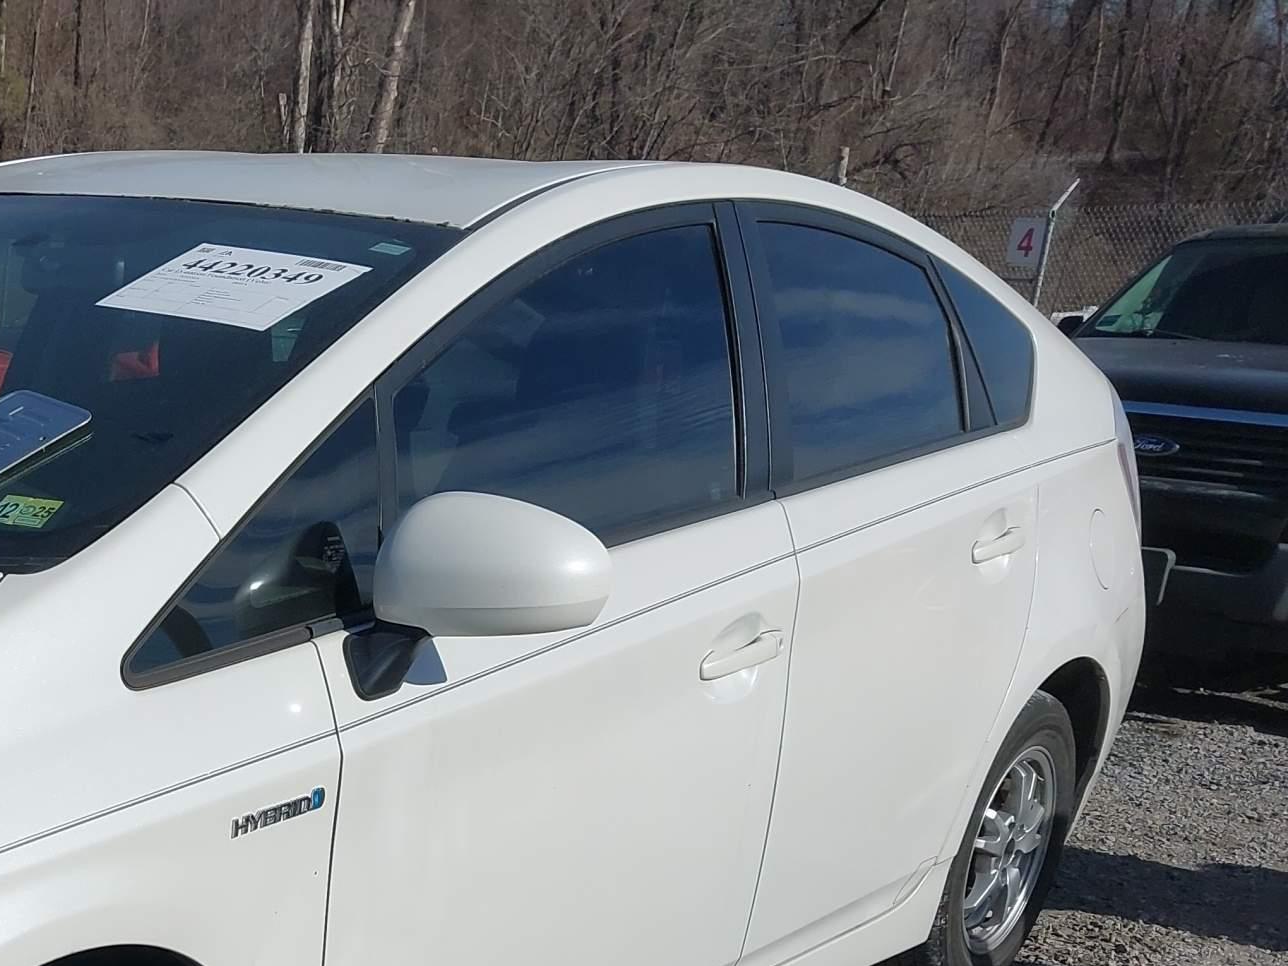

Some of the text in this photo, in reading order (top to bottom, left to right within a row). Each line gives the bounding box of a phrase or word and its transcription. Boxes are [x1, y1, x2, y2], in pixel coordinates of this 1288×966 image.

[1016, 228, 1034, 257] 4
[182, 258, 324, 285] 44220349
[32, 506, 55, 518] 25
[231, 795, 313, 839] HYBRID
